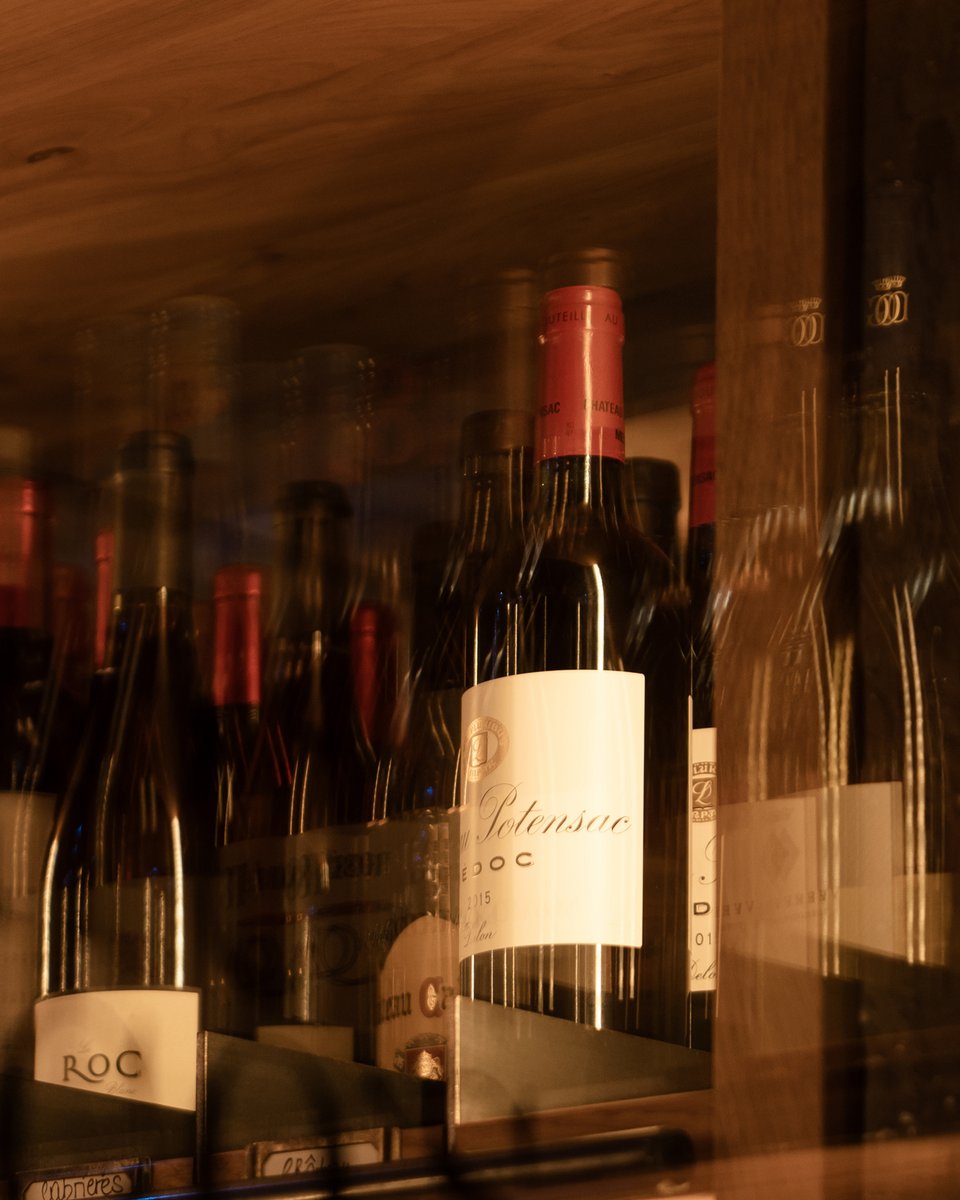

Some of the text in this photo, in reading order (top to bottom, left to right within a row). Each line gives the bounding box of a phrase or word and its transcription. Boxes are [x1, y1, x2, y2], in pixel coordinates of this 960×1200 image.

[583, 399, 621, 417] HATEA
[476, 782, 631, 844] Potensac
[462, 851, 534, 883] ÉDOC
[62, 1050, 142, 1083] ROC
